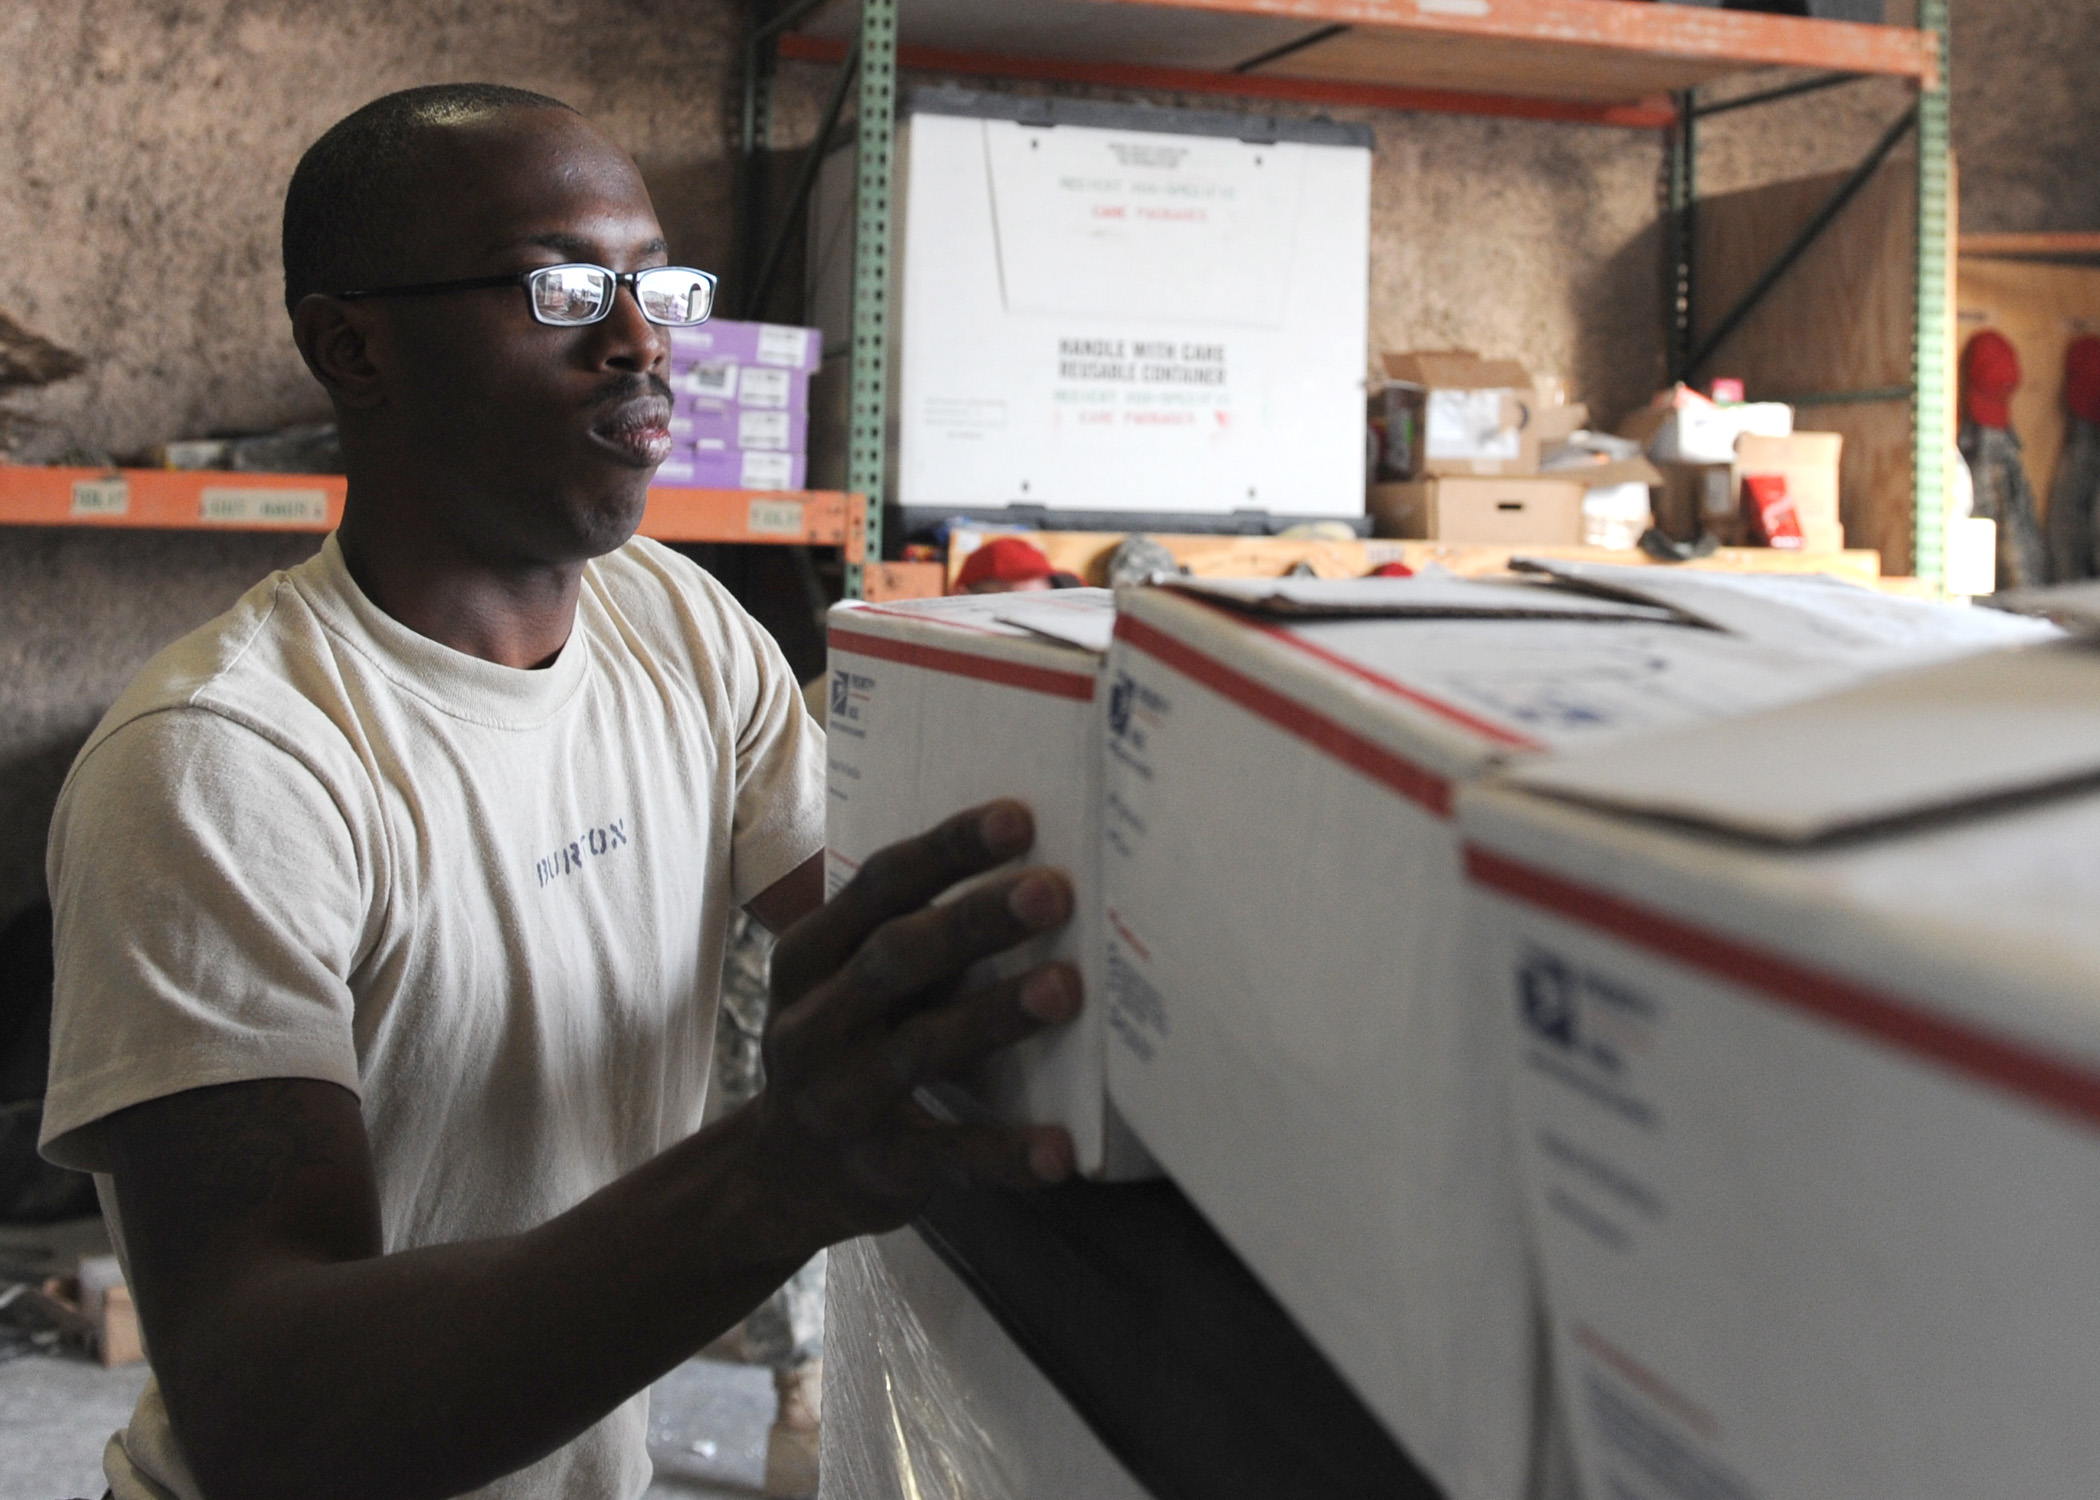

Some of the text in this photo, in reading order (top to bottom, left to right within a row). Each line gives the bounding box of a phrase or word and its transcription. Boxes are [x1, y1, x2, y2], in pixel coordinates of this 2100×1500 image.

[1058, 338, 1225, 363] HANDLE WITH CARE
[1058, 361, 1226, 385] REUSABLE CONTAINER
[536, 817, 627, 888] BURON
